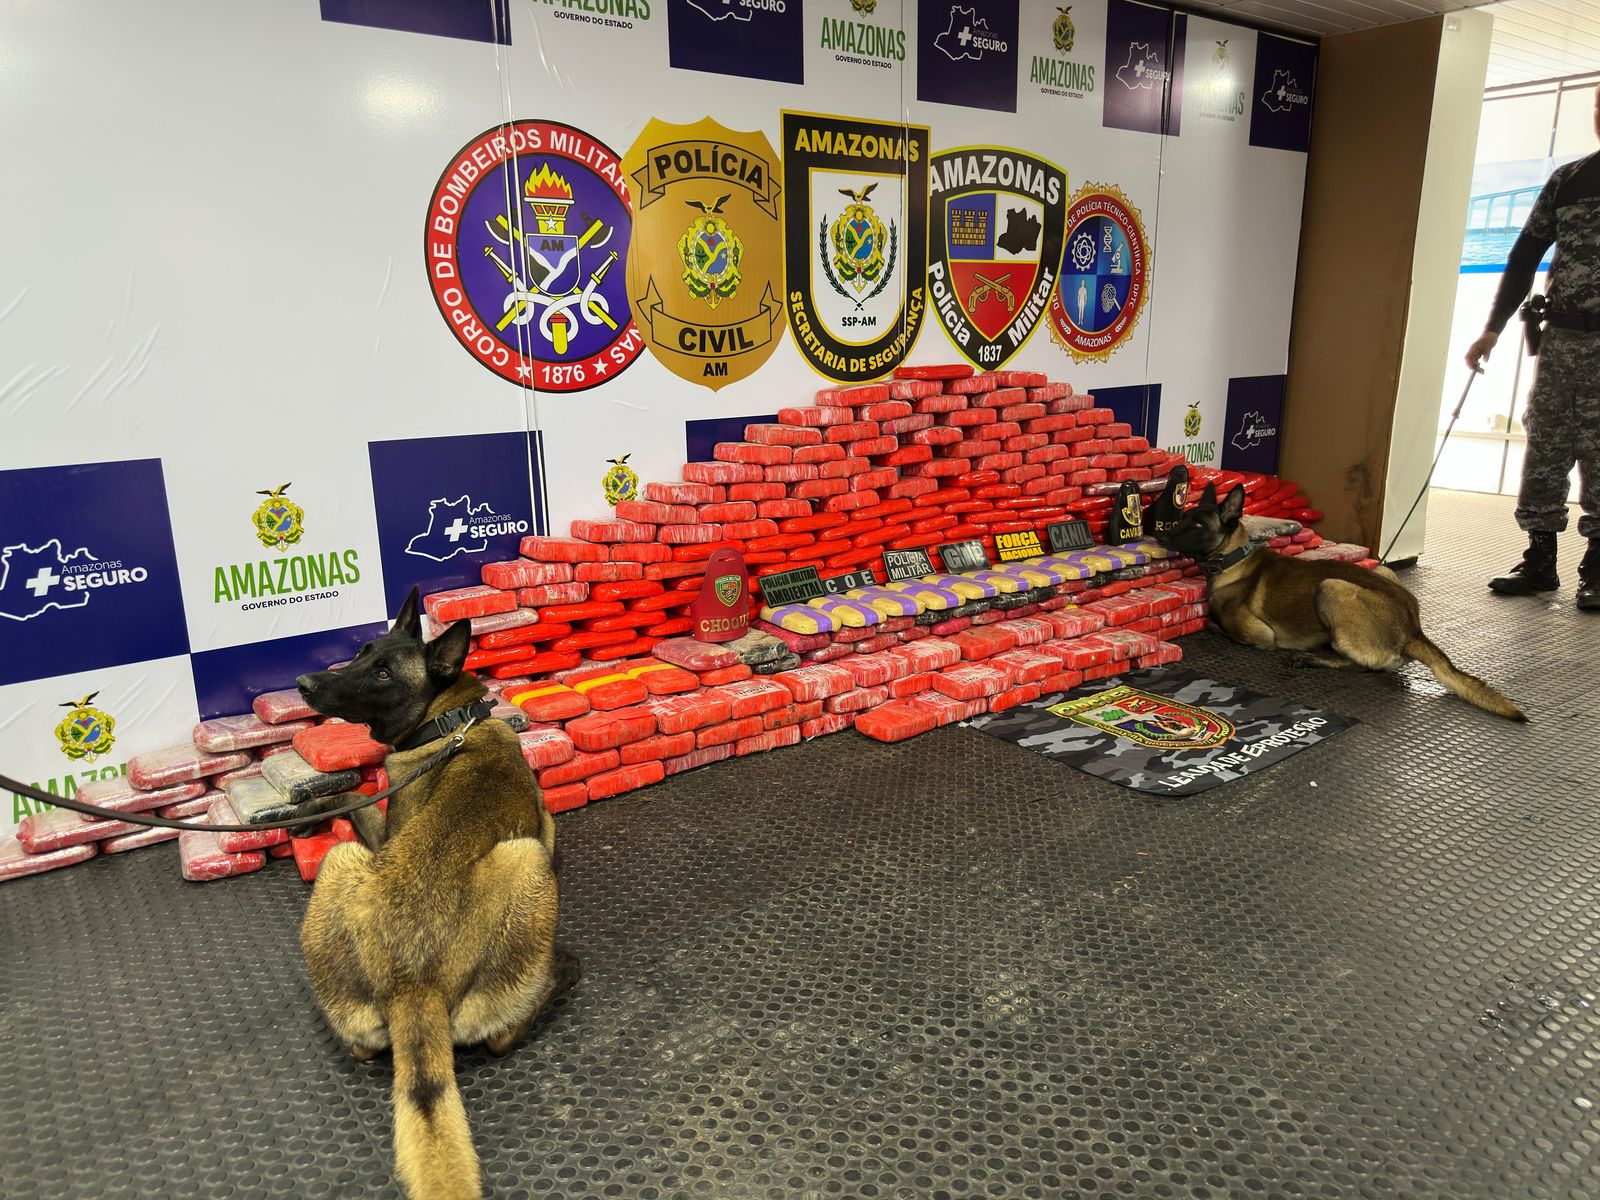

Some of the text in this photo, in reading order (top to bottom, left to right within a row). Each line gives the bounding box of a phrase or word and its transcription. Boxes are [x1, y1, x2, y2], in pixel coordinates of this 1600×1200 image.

[554, 11, 633, 29] GOVERNO DO ESTADO
[821, 17, 906, 61] AMAZONAS
[973, 37, 1007, 52] SEGURO
[835, 55, 892, 69] GOVERNO DO ESTADO
[1030, 56, 1095, 92] AMAZONAS
[1041, 88, 1061, 96] GOVERNO
[1286, 92, 1309, 105] SEGURO
[795, 128, 919, 162] AMAZONAS
[654, 145, 763, 190] POLÍCIA
[434, 129, 541, 235] BOMBEIROS
[930, 155, 1061, 205] AMAZONAS
[541, 240, 564, 252] AM
[1067, 214, 1077, 227] DE
[1077, 201, 1102, 218] POLÍCIA
[1104, 202, 1141, 275] TÉCNICO-CIENTÍFICA
[1129, 284, 1139, 309] DPTC
[434, 243, 455, 279] DE
[928, 261, 1054, 347] Polícia Militar
[443, 288, 509, 366] CORPO
[790, 287, 924, 373] SECRETARIA DE SEGURANÇA
[842, 316, 877, 327] SSP-AM
[678, 326, 754, 353] CIVIL
[1075, 333, 1112, 347] AMAZONAS
[978, 345, 1002, 362] 1837
[542, 365, 586, 384] 1876
[703, 362, 728, 376] AM
[1254, 427, 1276, 438] SEGURO
[469, 513, 511, 524] Amazonas
[470, 520, 528, 538] SEGURO
[1050, 522, 1093, 549] CANIL
[996, 531, 1040, 549] FORÇA
[1000, 546, 1044, 561] NACIONAL
[62, 560, 122, 574] Amazonas
[215, 549, 361, 604] AMAZONAS
[63, 567, 148, 591] SEGURO
[242, 591, 339, 611] GOVERNO DO ESTADO
[767, 582, 824, 605] AMBIENTAL
